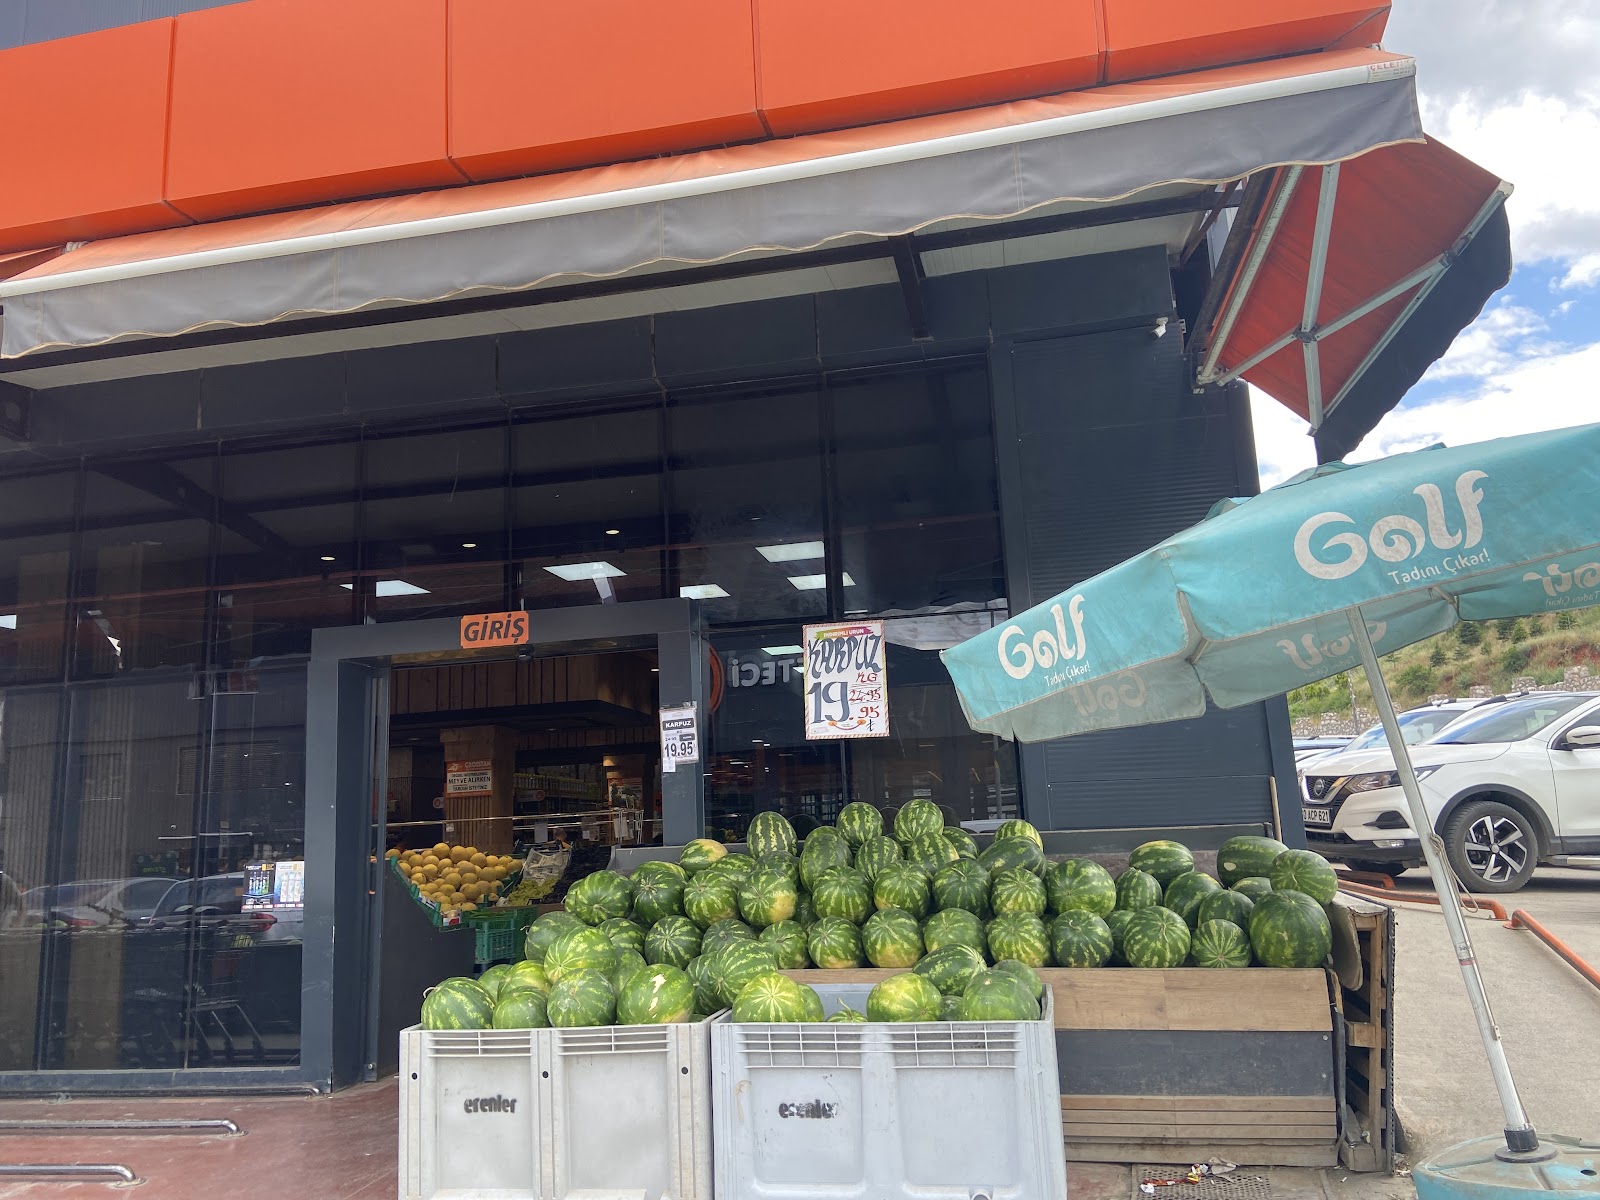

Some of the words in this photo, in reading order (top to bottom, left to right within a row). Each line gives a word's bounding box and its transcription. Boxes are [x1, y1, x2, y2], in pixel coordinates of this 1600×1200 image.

[1293, 469, 1489, 580] Golf
[1387, 564, 1442, 585] Tadını
[1442, 548, 1491, 576] Çıkar!
[463, 613, 525, 644] GİRİŞ
[998, 593, 1086, 680] Golf
[805, 634, 883, 679] KARPUZ
[857, 672, 878, 684] KG
[1066, 660, 1091, 681] Çıkar!
[665, 720, 692, 729] KARPUZ
[665, 742, 693, 757] 19.95
[468, 775, 491, 783] ALIRKEN
[1308, 809, 1318, 820] ACP
[1318, 810, 1329, 822] 621
[463, 1094, 518, 1114] erenler
